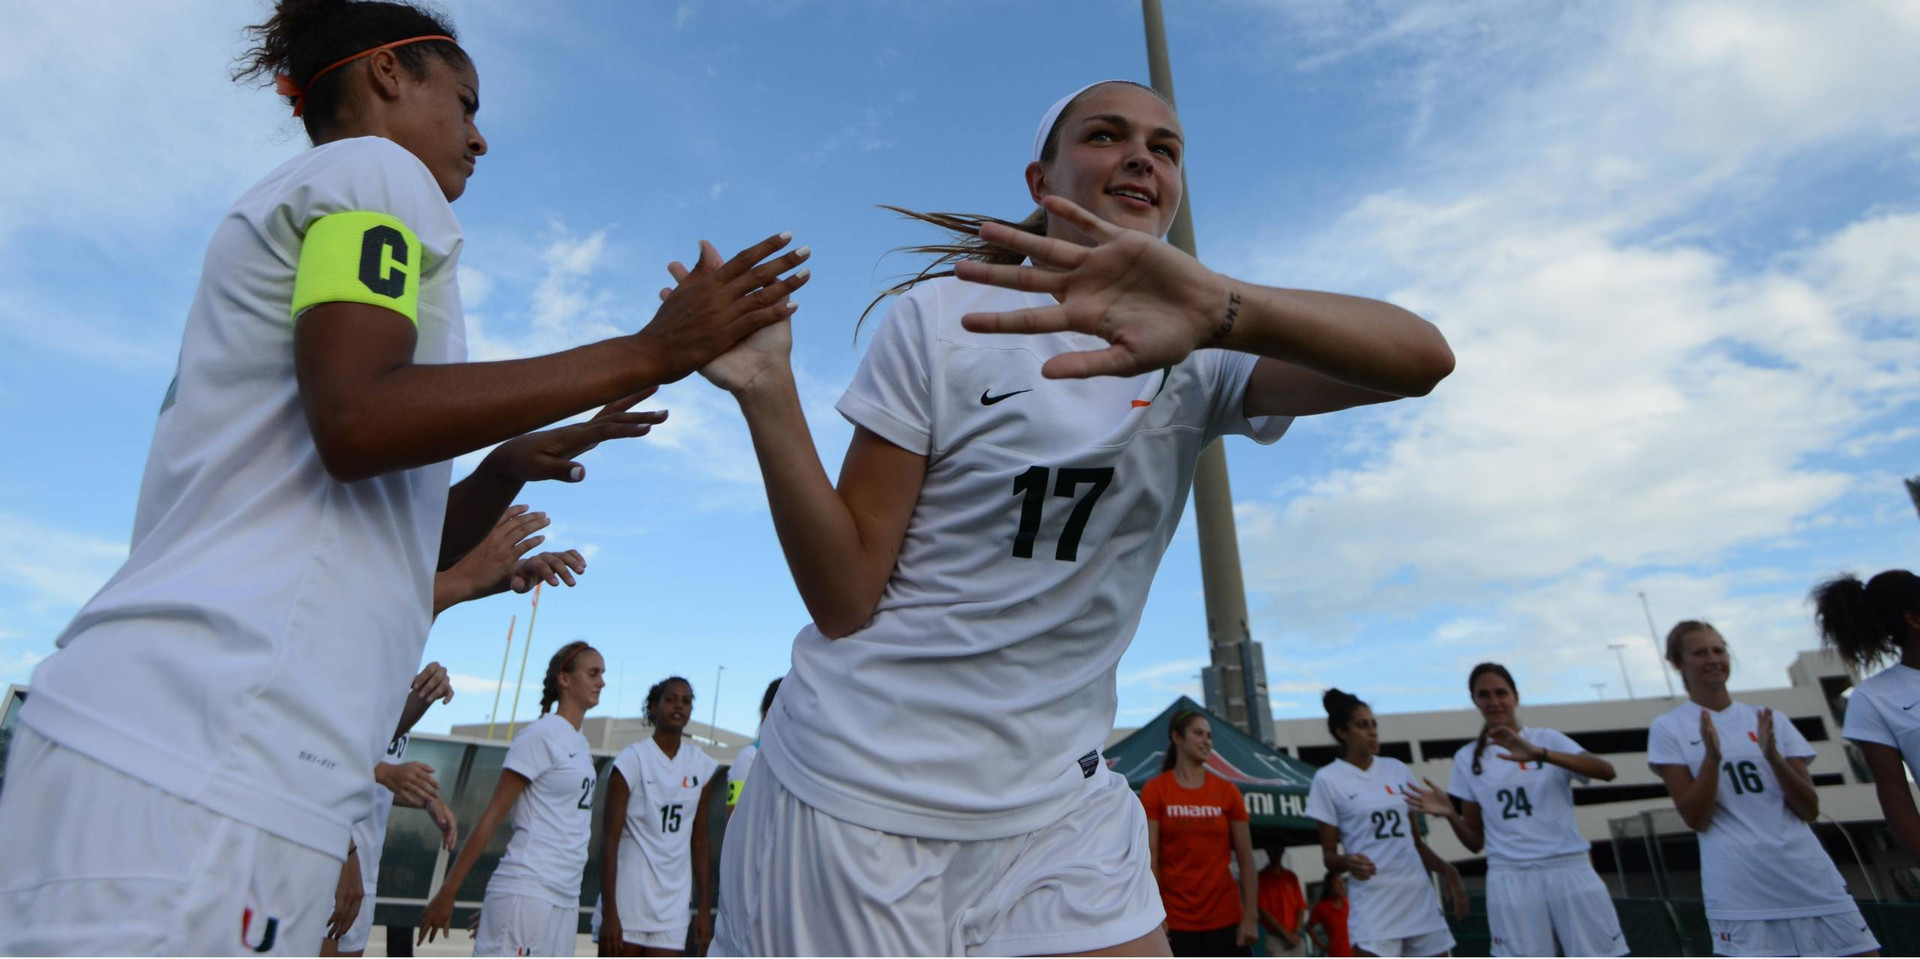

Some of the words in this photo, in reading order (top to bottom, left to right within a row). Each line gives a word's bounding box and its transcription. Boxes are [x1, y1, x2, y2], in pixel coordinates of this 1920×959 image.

[359, 225, 408, 299] C
[1012, 466, 1114, 561] 17
[1722, 760, 1764, 795] 16
[660, 805, 683, 833] 15
[1497, 786, 1533, 820] 24
[1371, 809, 1405, 840] 22
[242, 906, 279, 953] U
